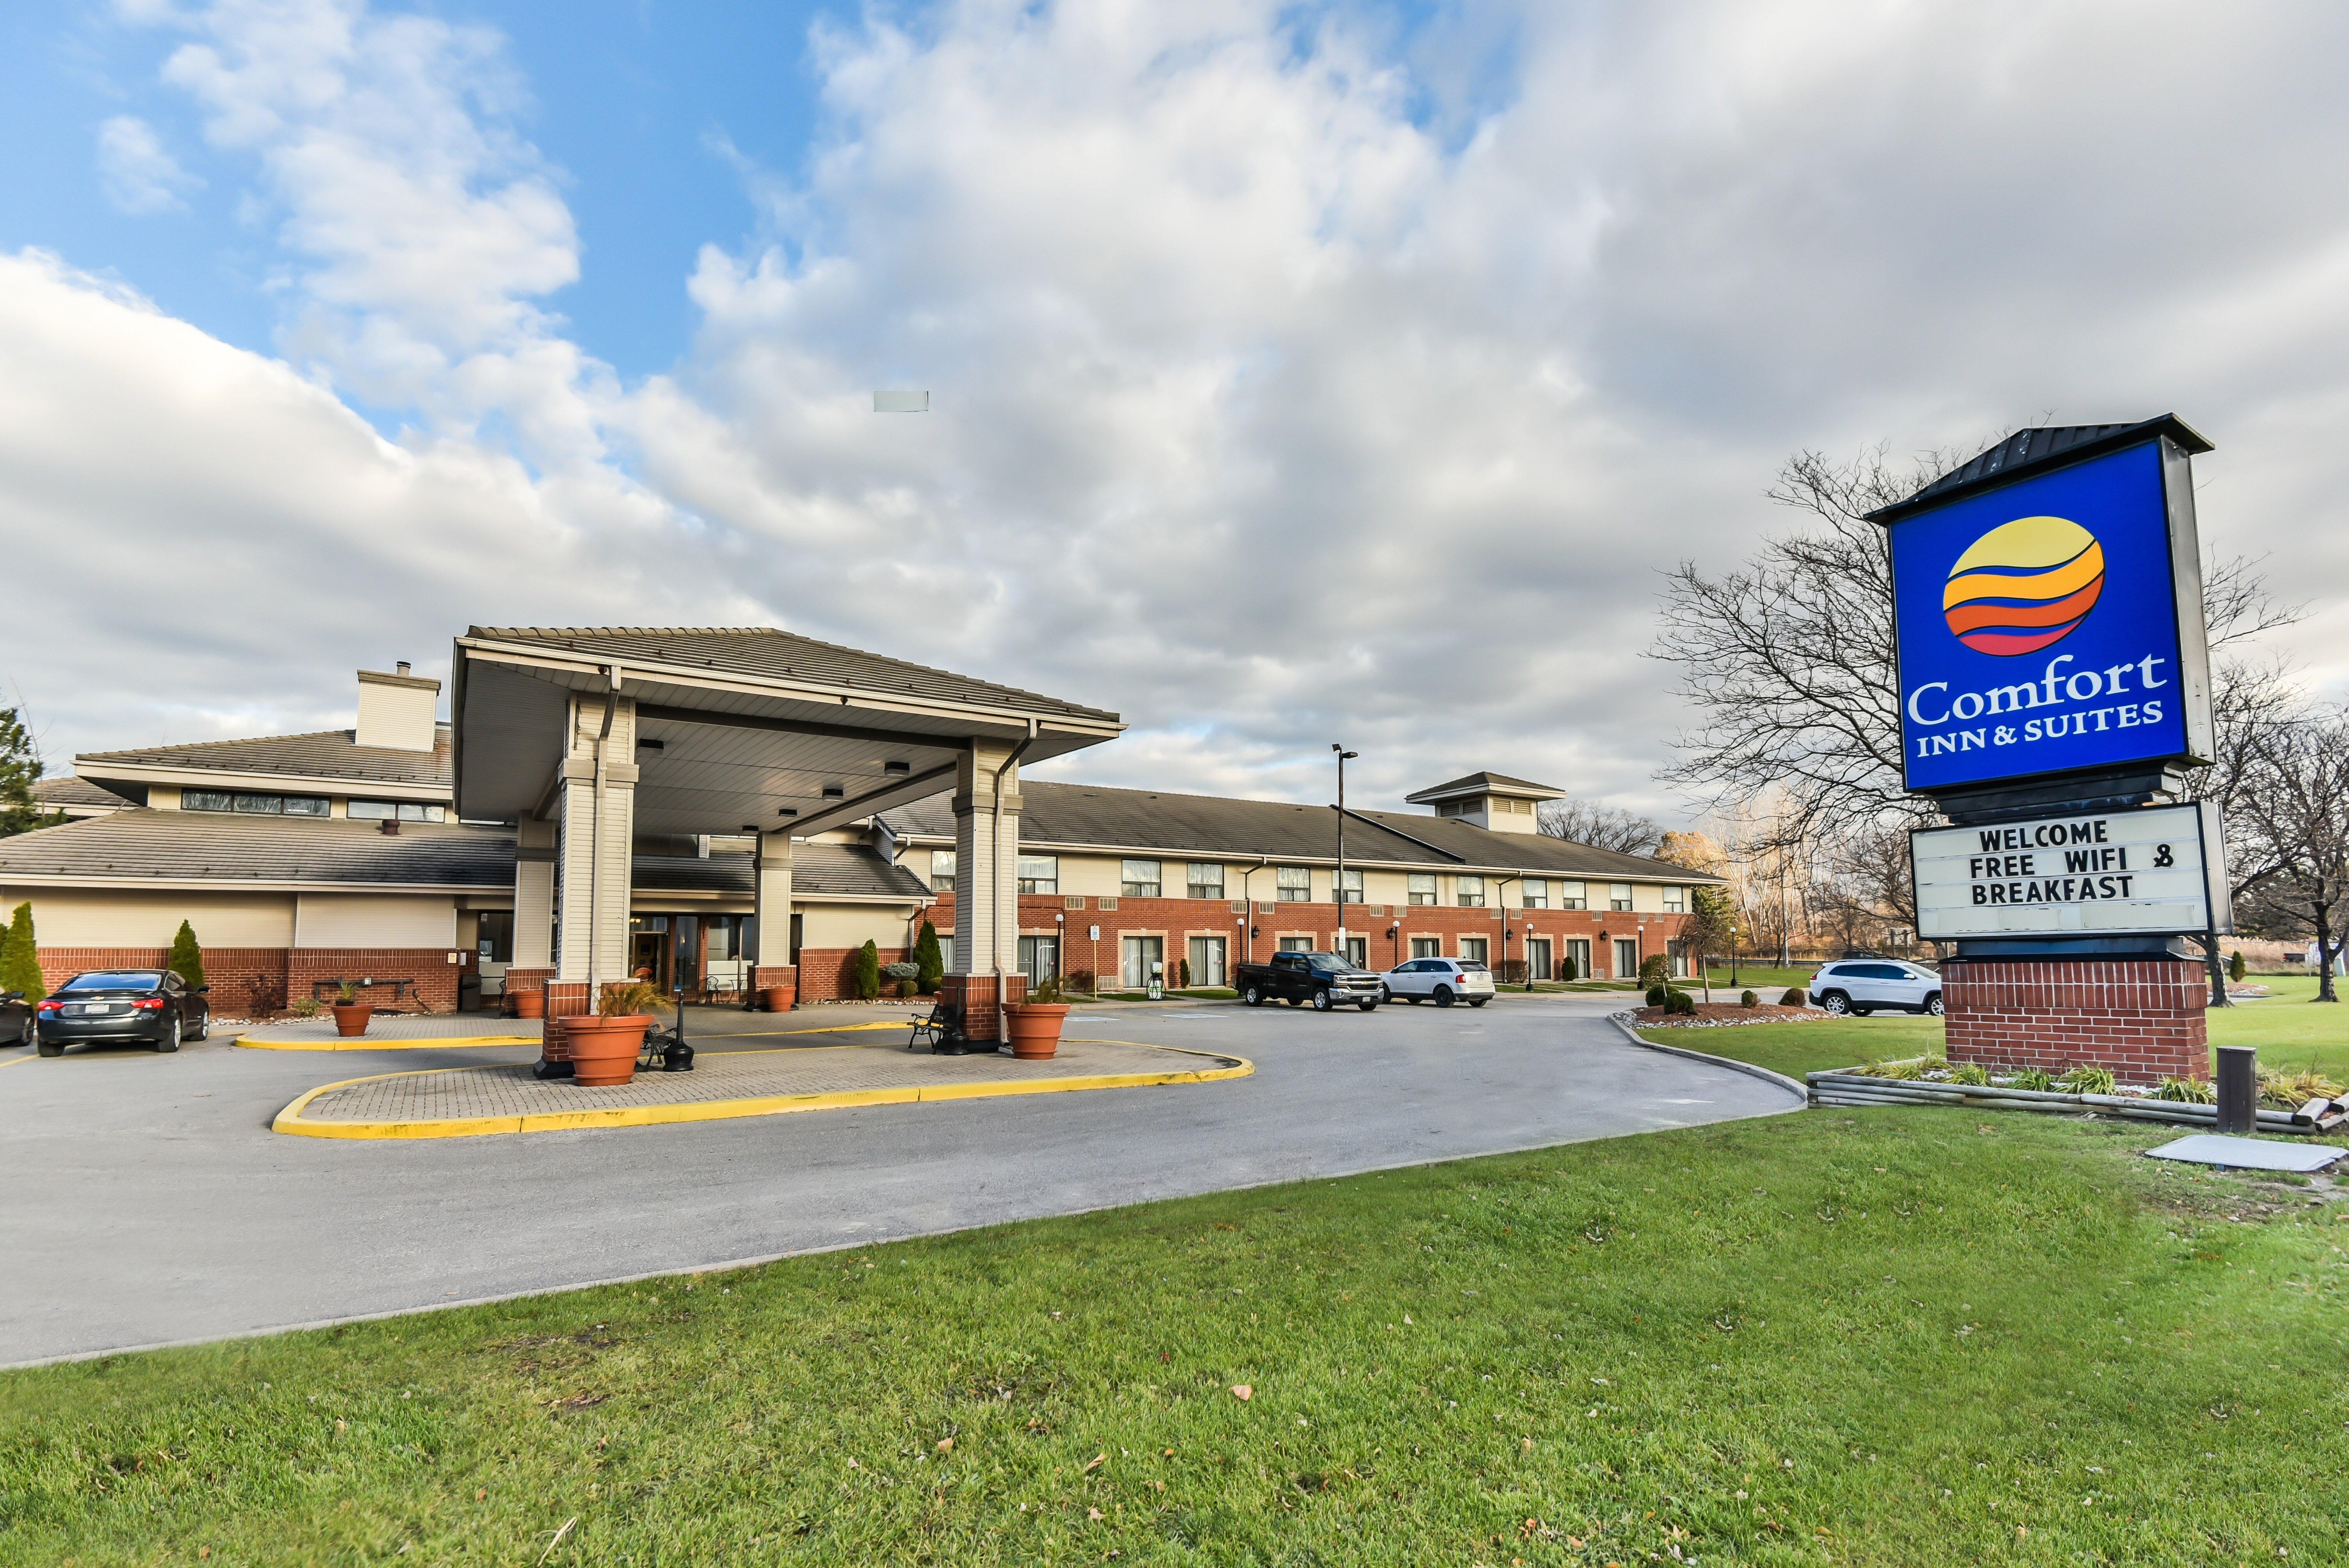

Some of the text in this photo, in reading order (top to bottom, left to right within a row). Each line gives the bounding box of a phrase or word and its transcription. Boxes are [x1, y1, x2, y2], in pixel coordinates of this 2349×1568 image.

[1908, 653, 2167, 725] Comfort
[1917, 700, 2163, 757] INN & SUITES
[1979, 820, 2108, 852] WELCOME
[1970, 844, 2174, 879] FREE WIFI &
[1972, 875, 2133, 905] BREAKFAST
